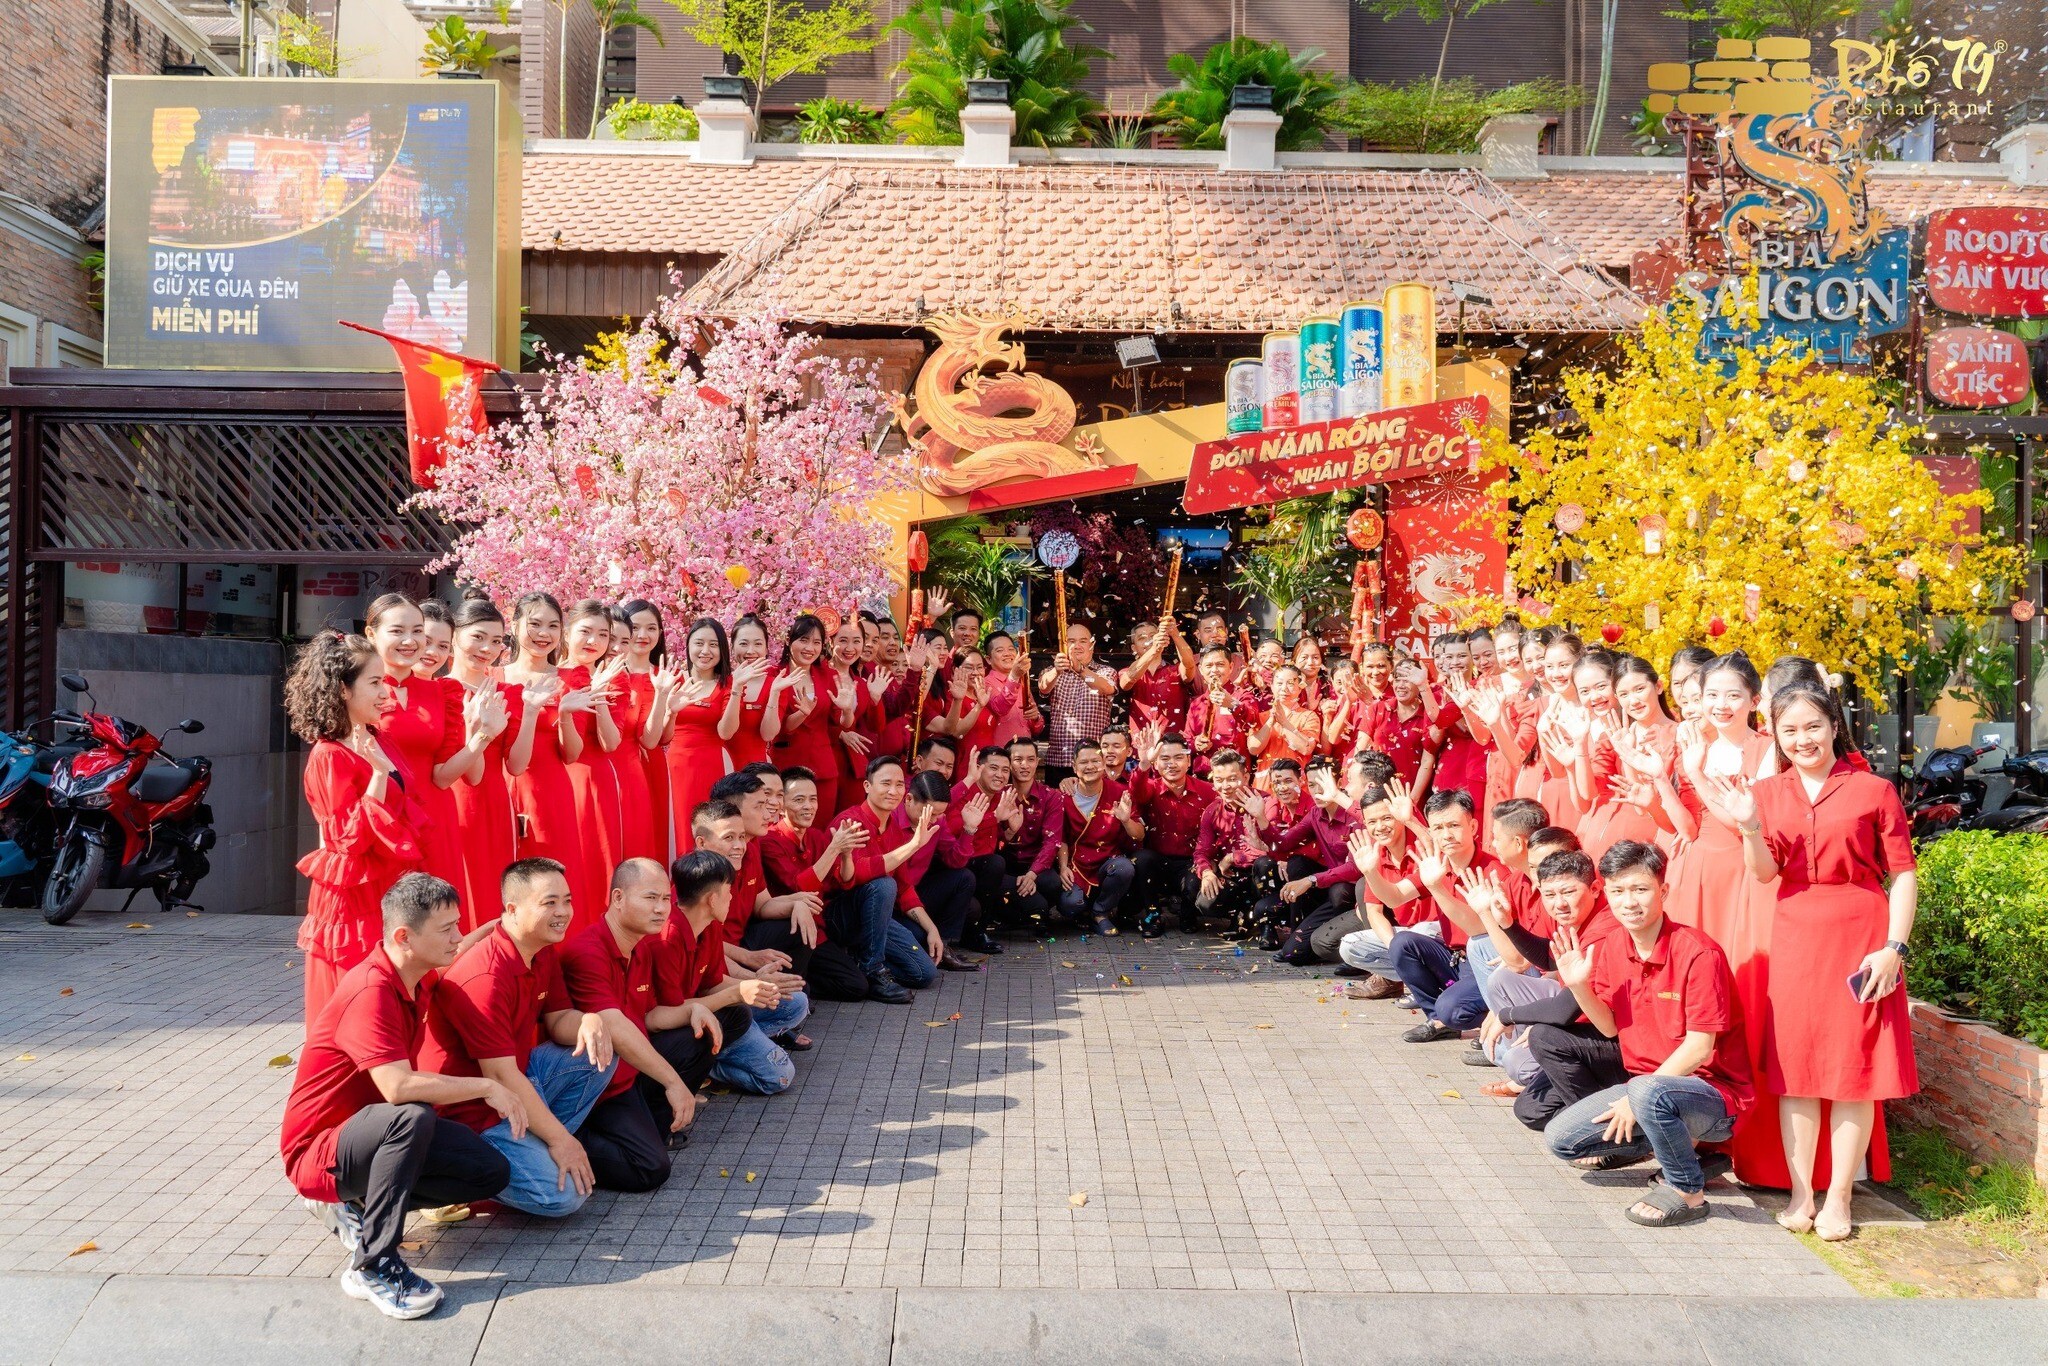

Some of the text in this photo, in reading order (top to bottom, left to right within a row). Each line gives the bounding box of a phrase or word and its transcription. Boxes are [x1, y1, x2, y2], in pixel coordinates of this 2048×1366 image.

[155, 252, 234, 277] DỊCH VỤ
[1760, 239, 1825, 269] BIA
[153, 274, 299, 299] GIỮ XE QUA ĐÊM
[1936, 260, 1994, 289] SÂN
[1672, 271, 1899, 323] SAIGON
[152, 297, 259, 335] MIỄN PHÍ
[1947, 337, 2012, 363] SẢNH
[1301, 380, 1338, 391] SAIGON
[1342, 369, 1382, 381] SAIGON
[1228, 403, 1261, 413] SAIGON
[1210, 416, 1407, 471] ĐÓN NĂM RỒNG
[1293, 434, 1466, 486] NHÂN BỘI LỘC
